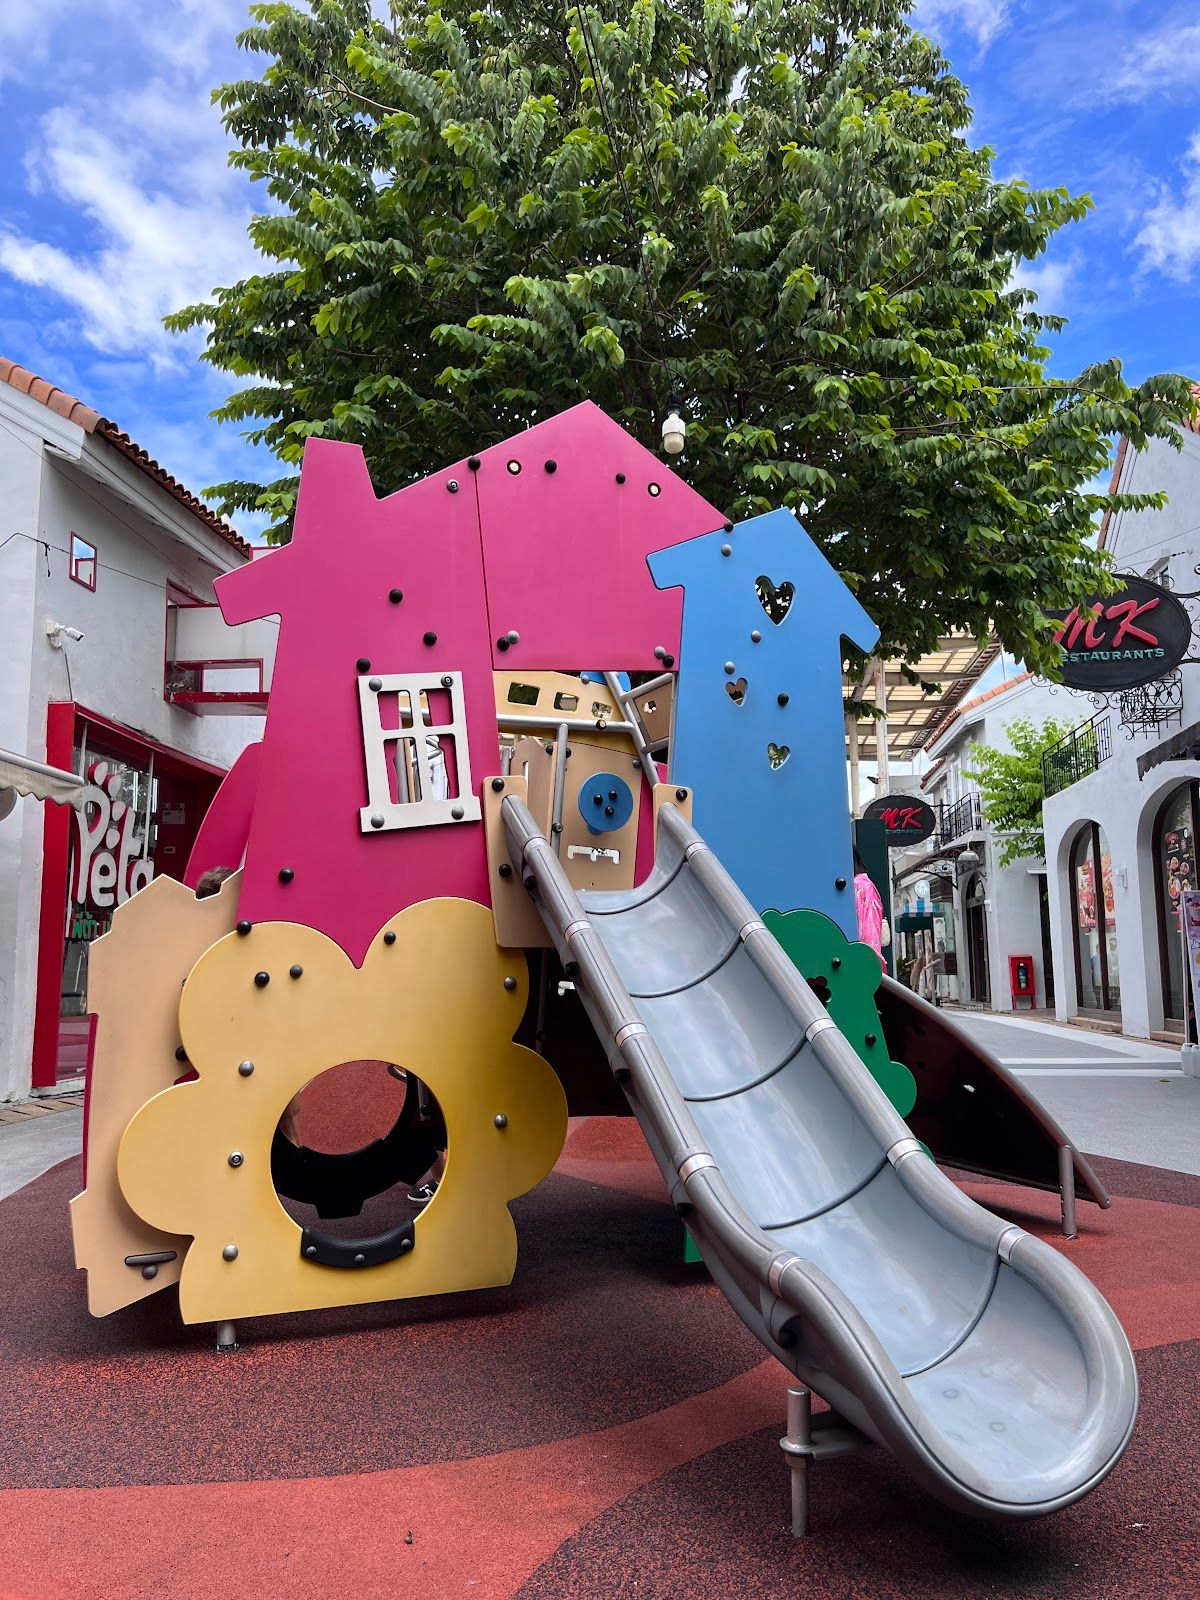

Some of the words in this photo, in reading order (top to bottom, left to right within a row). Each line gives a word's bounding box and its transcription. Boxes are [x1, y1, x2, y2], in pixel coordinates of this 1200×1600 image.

[1053, 598, 1160, 650] MK
[1060, 647, 1165, 663] ESTAURANTS
[880, 807, 924, 830] MK
